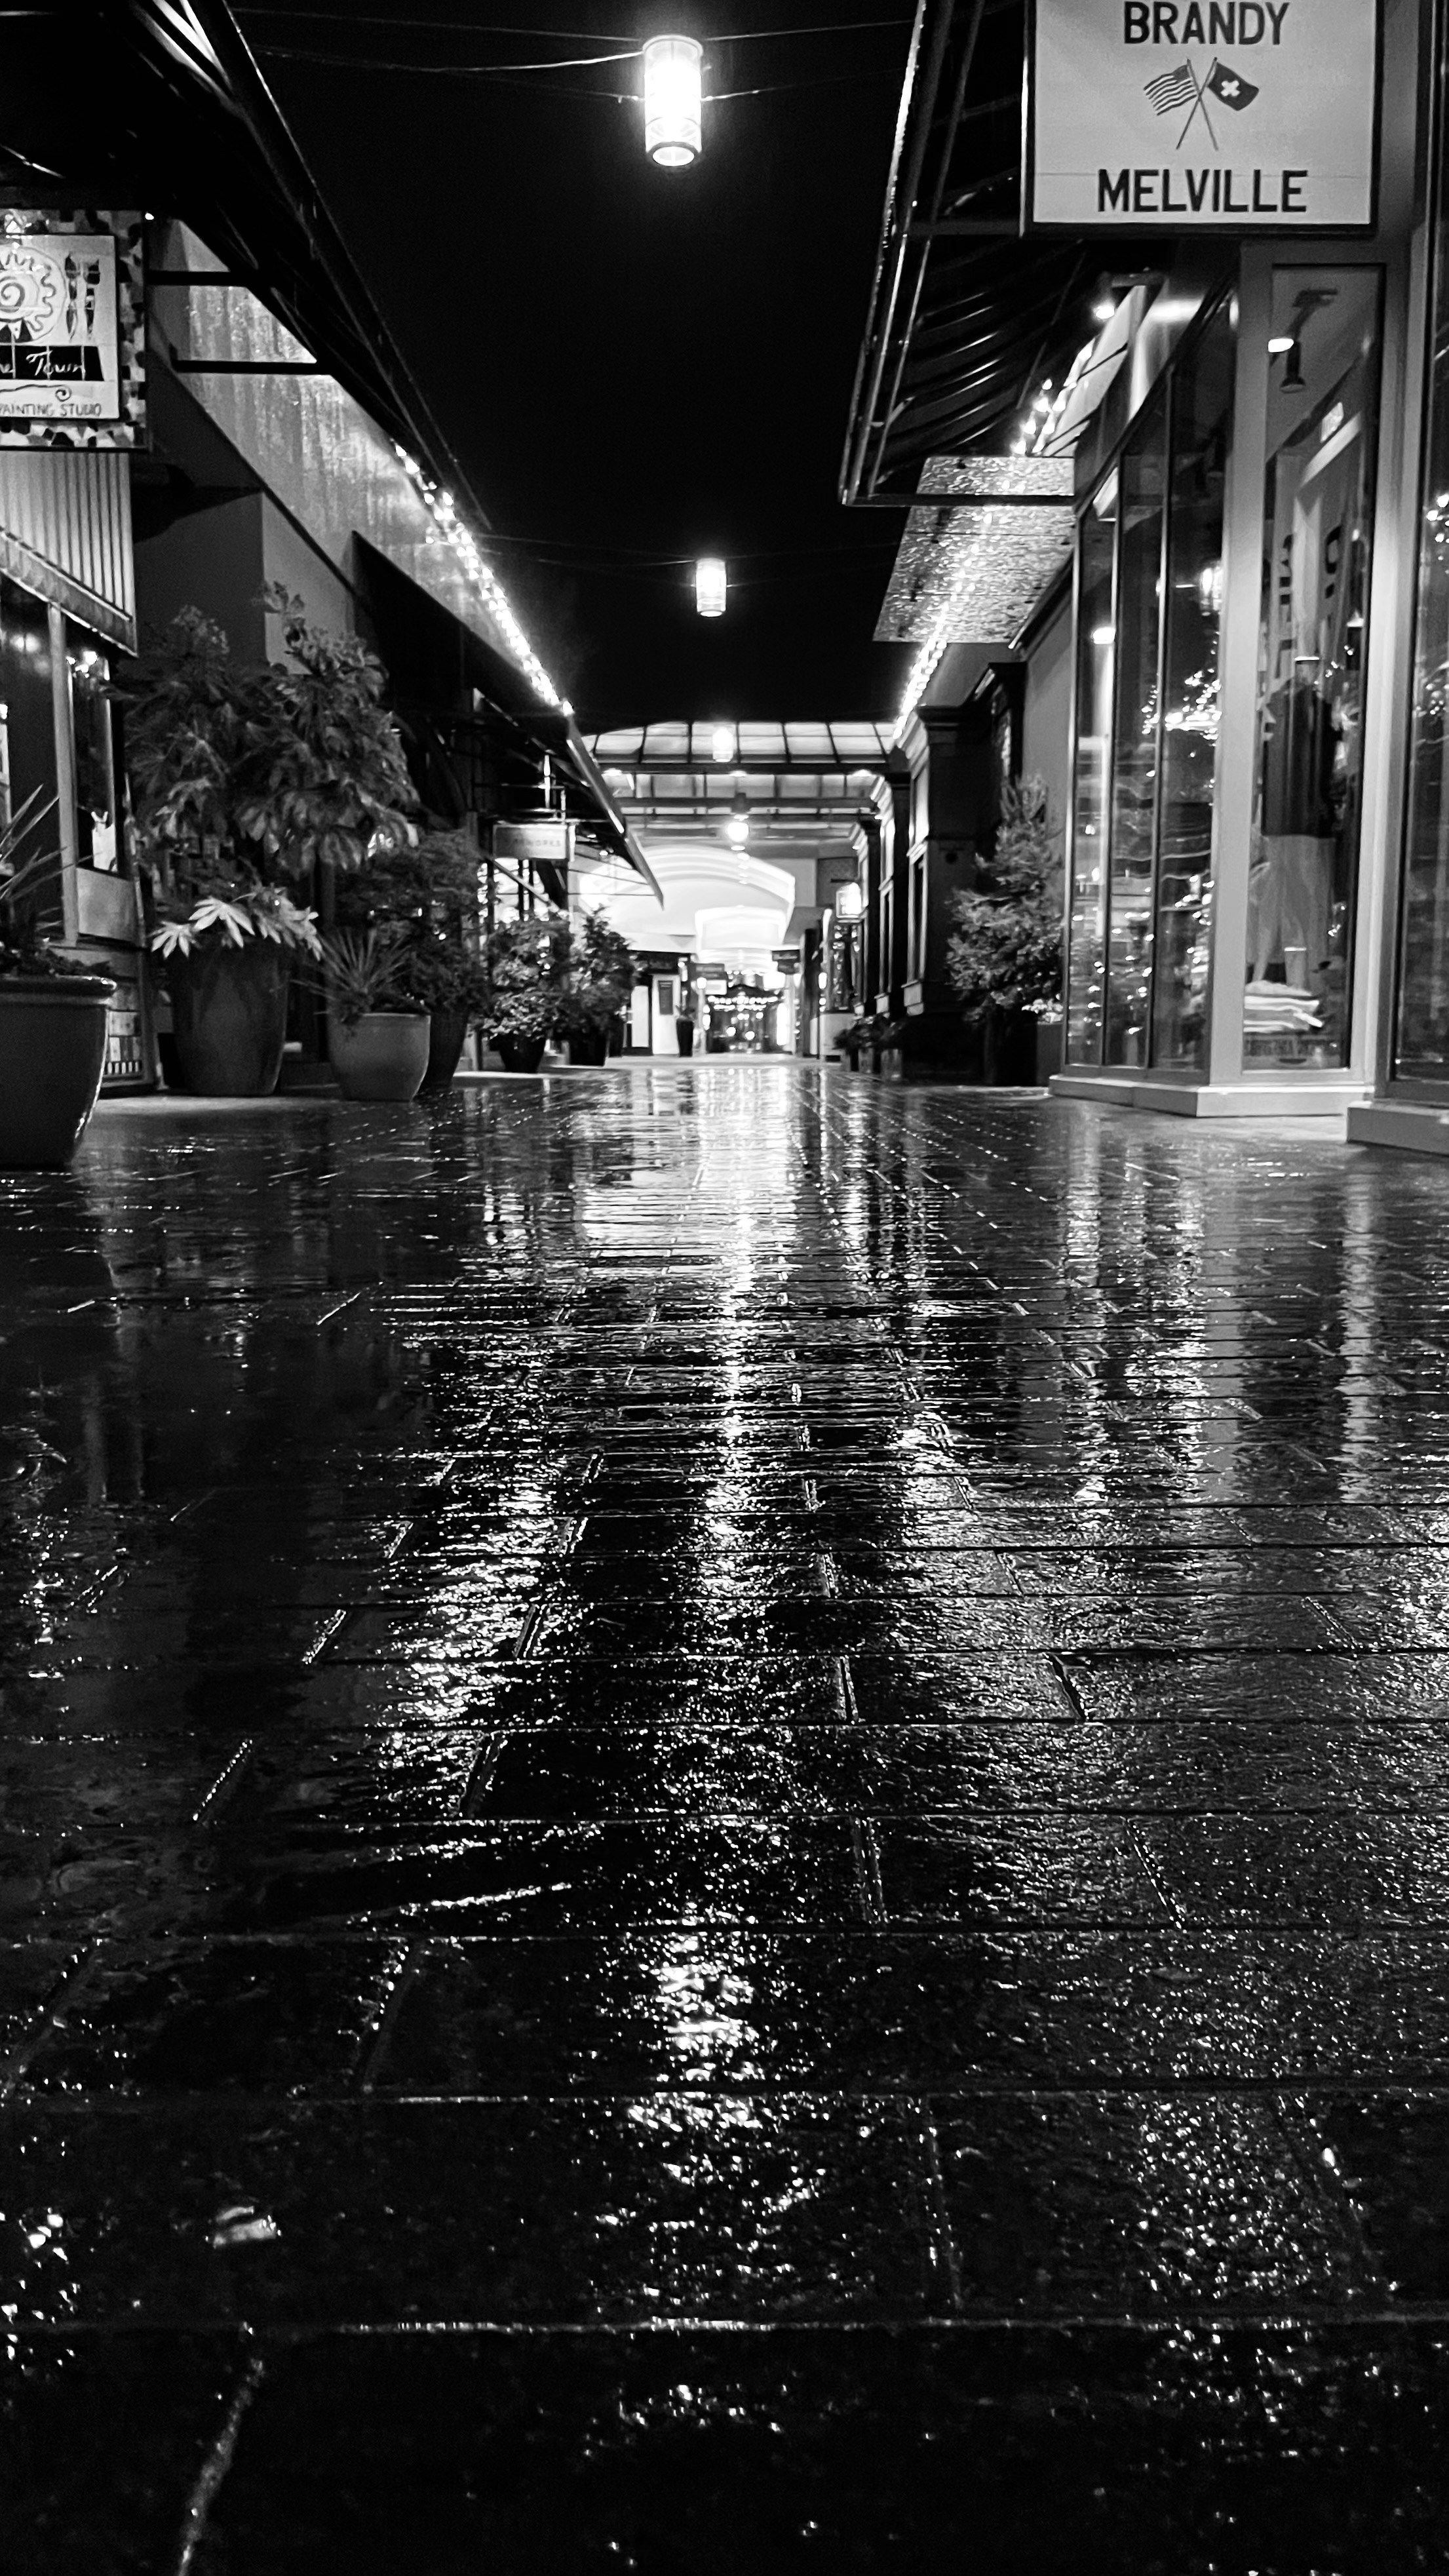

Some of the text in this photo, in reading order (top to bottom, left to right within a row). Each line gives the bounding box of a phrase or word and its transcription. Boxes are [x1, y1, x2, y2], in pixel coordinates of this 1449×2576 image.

[1124, 1, 1290, 45] BRANDY
[1097, 168, 1309, 212] MELVILLE
[26, 350, 86, 376] Town
[60, 403, 102, 417] STUDIO
